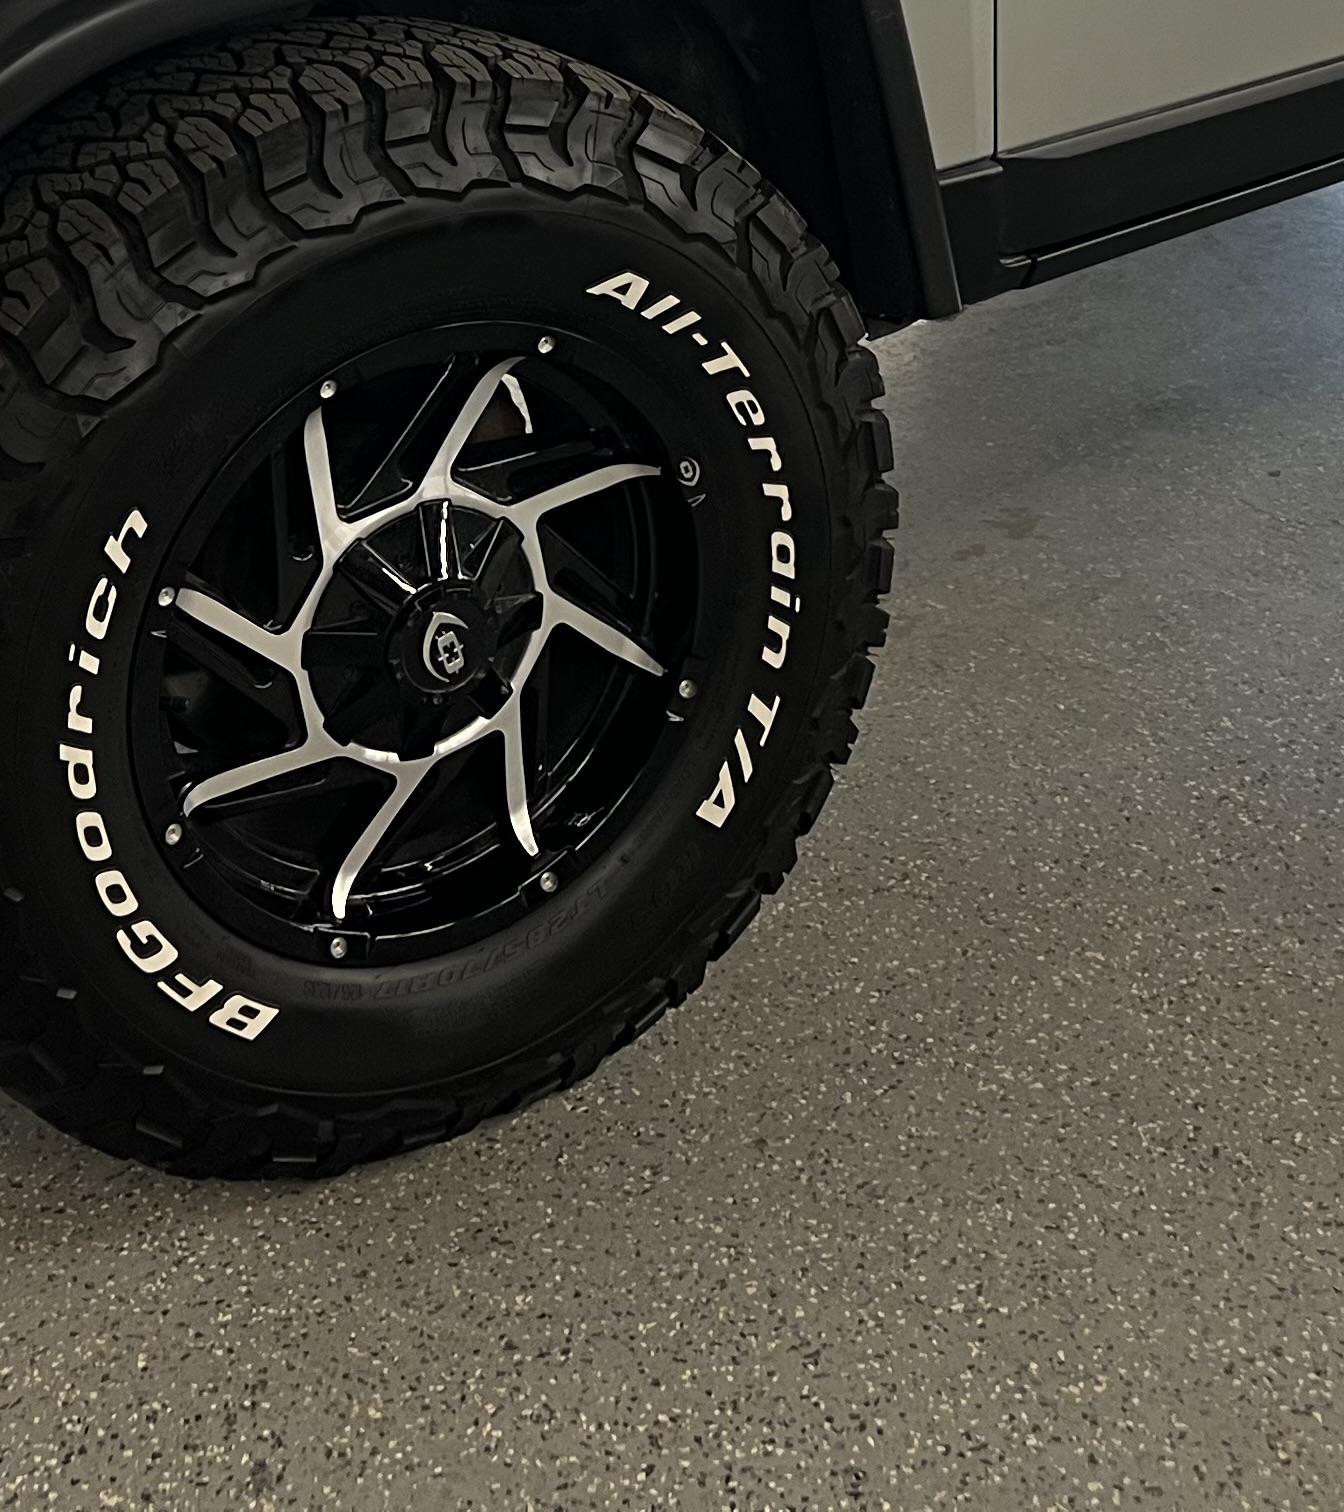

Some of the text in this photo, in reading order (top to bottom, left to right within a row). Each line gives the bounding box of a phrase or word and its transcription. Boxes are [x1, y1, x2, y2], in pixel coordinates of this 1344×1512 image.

[58, 508, 281, 1042] BFGoodrich
[586, 271, 800, 671] All-Terrain
[694, 692, 782, 830] T/A
